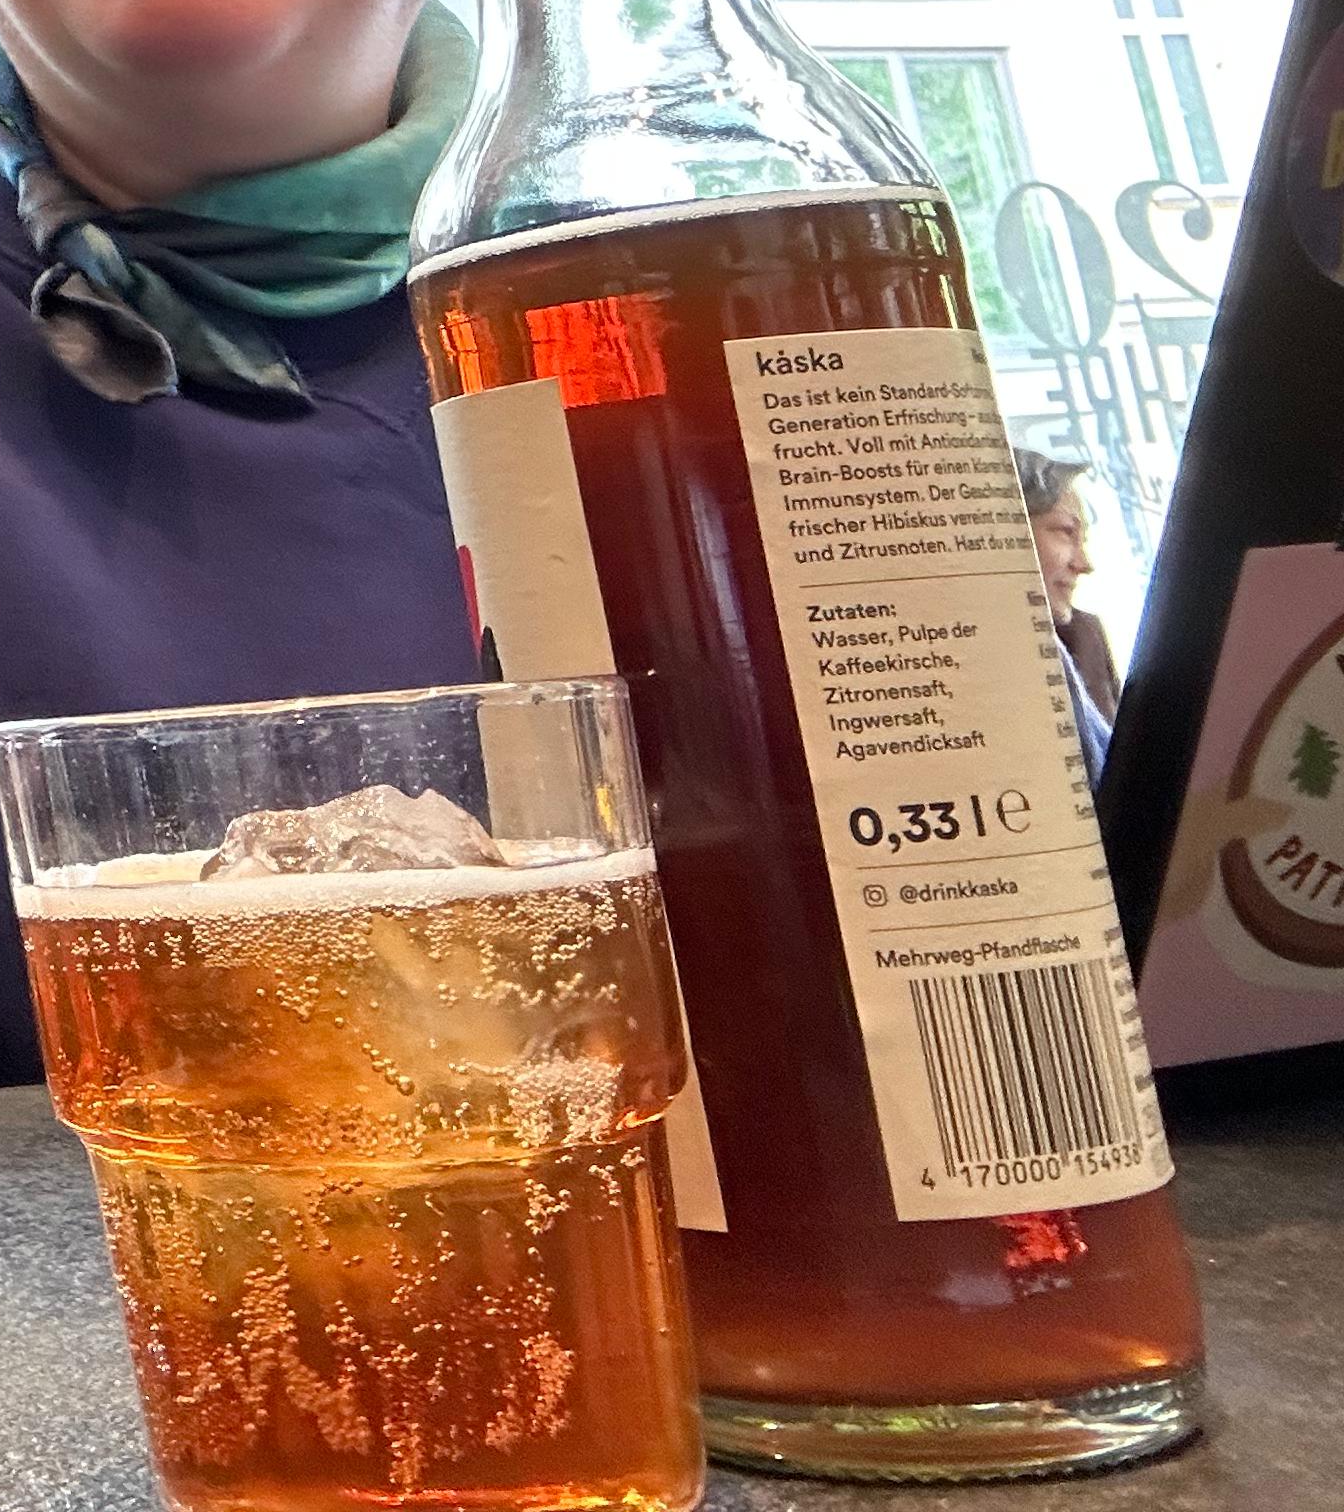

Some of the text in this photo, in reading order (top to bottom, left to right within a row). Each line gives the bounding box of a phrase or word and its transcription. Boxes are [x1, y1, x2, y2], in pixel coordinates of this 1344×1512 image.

[763, 392, 802, 409] Das
[805, 389, 831, 406] ist
[835, 386, 877, 403] kein
[768, 411, 880, 435] Generation
[883, 407, 967, 427] Erfrischung
[773, 440, 843, 461] frucht.
[846, 436, 885, 455] Voll
[889, 433, 919, 452] mit
[778, 463, 903, 487] Brain-Boosts
[906, 460, 930, 477] für
[933, 458, 971, 475] einen
[784, 488, 926, 512] Immunsystem.
[928, 484, 955, 501] Der
[788, 517, 867, 538] frischer
[871, 509, 948, 531] Hibiskus
[793, 544, 835, 564] und
[838, 539, 952, 561] Zitrusnoten.
[806, 603, 897, 623] Zutaten:
[812, 621, 978, 649] Wasser, Pulpe der
[818, 651, 960, 677] Kaffeekirsche,
[823, 679, 954, 705] Zitronensaft,
[829, 706, 945, 734] Ingwersaft,
[836, 730, 987, 762] Agavendicksaft
[849, 801, 961, 854] 0,33
[899, 877, 1019, 904] @drinkkaska
[875, 934, 1082, 968] Mehrweg-Pfandflasche
[961, 1157, 1062, 1188] 170000
